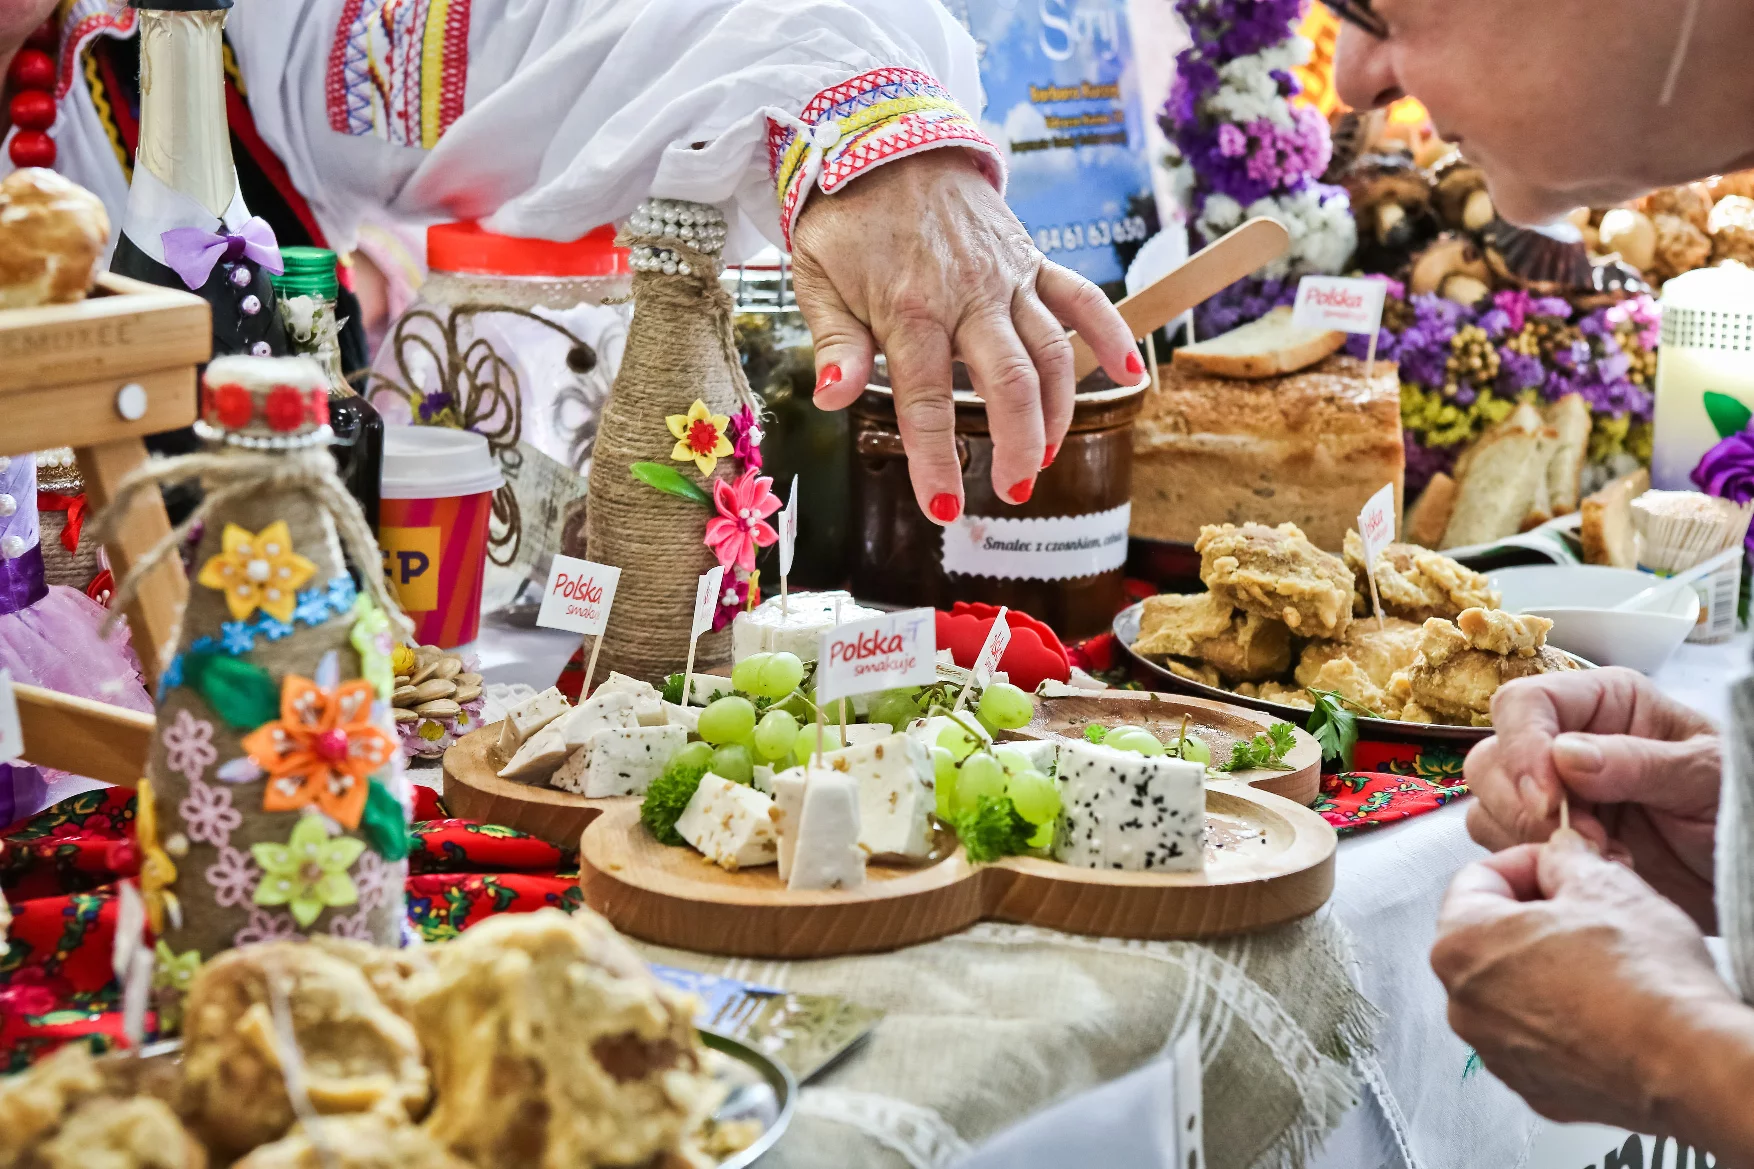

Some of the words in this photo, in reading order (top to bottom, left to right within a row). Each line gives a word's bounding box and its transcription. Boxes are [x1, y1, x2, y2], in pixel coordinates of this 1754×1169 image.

[983, 536, 1032, 552] Smalec
[552, 572, 604, 605] Polska
[829, 629, 904, 668] Polska
[854, 652, 917, 677] smakuje
